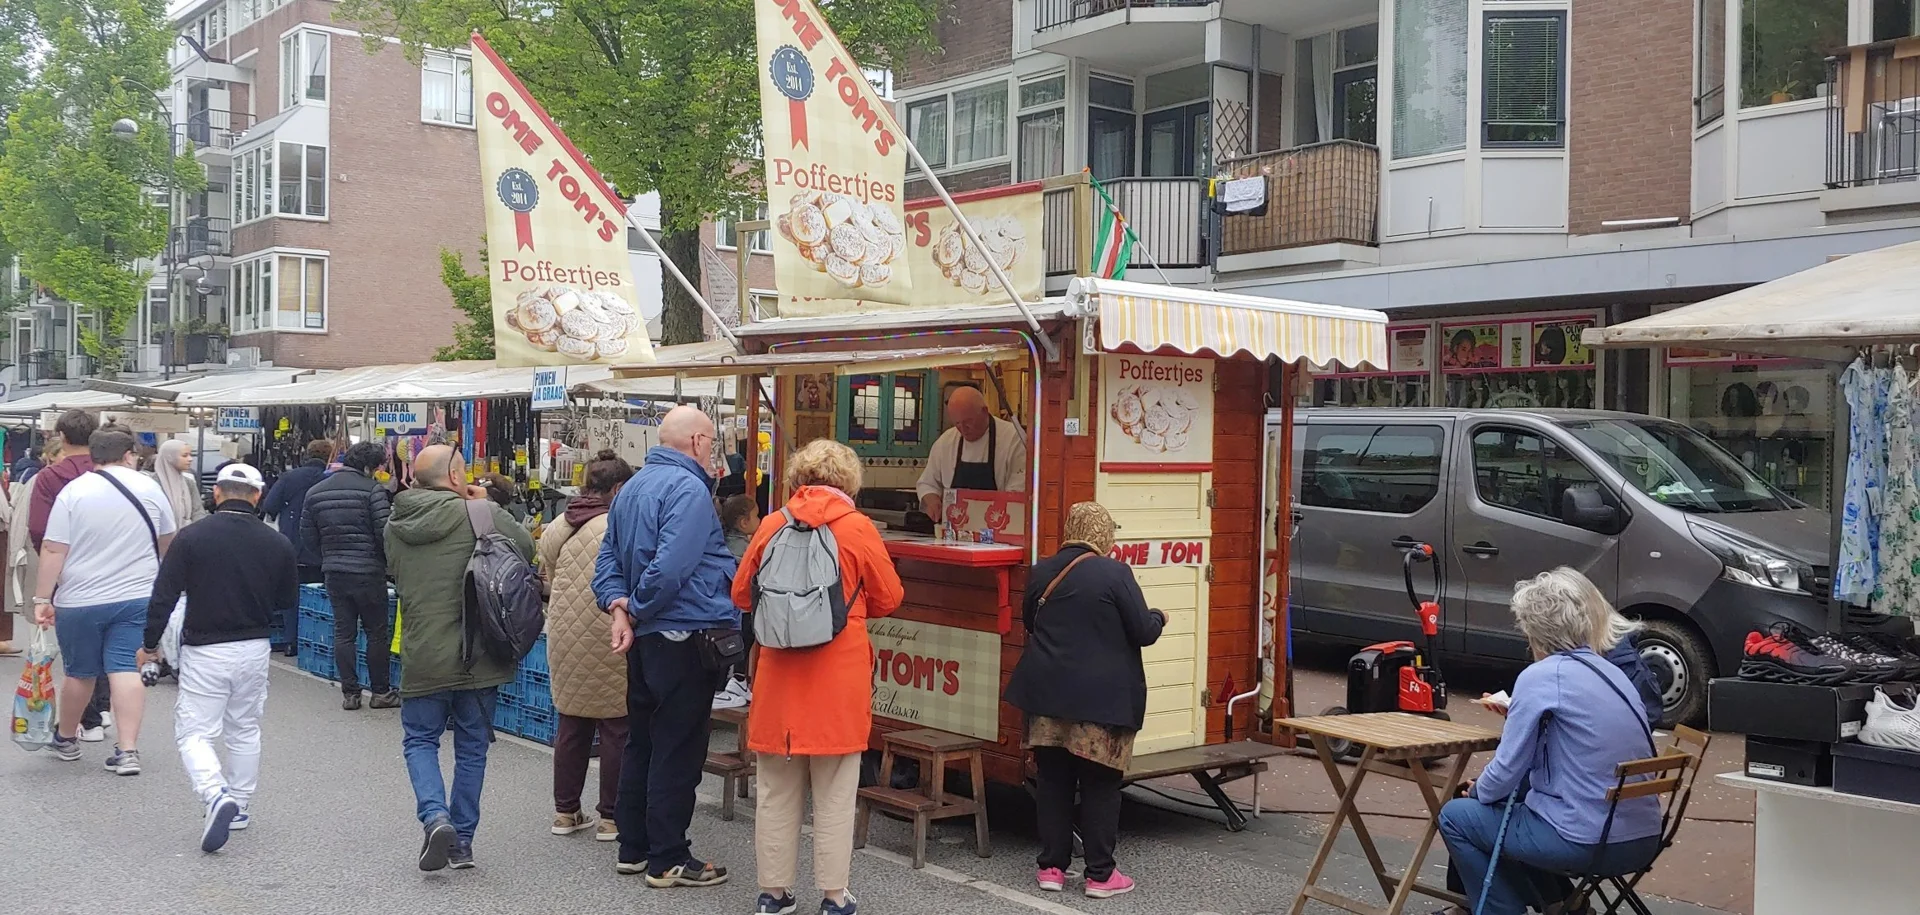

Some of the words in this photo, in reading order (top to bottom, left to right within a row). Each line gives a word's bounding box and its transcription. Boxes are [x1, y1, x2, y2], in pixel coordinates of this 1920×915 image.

[773, 0, 823, 52] ME
[825, 56, 896, 157] TOM'S
[486, 91, 545, 156] OME
[546, 157, 620, 243] TOM'S
[773, 158, 896, 205] Poffertjes
[501, 259, 621, 290] Poffertjes
[534, 370, 557, 386] PINNEN
[1119, 358, 1203, 386] Poffertjes
[533, 387, 542, 401] JA
[542, 385, 564, 401] GRAAG
[220, 407, 250, 418] PINNEN
[378, 403, 410, 413] BETAAL
[378, 413, 397, 423] HIER
[399, 412, 417, 423] OOK
[220, 418, 231, 428] JA
[232, 418, 261, 429] GRAAG
[1161, 541, 1204, 565] TOM
[886, 625, 920, 647] biologisch
[878, 648, 960, 697] TOM'S
[1409, 681, 1420, 693] F4
